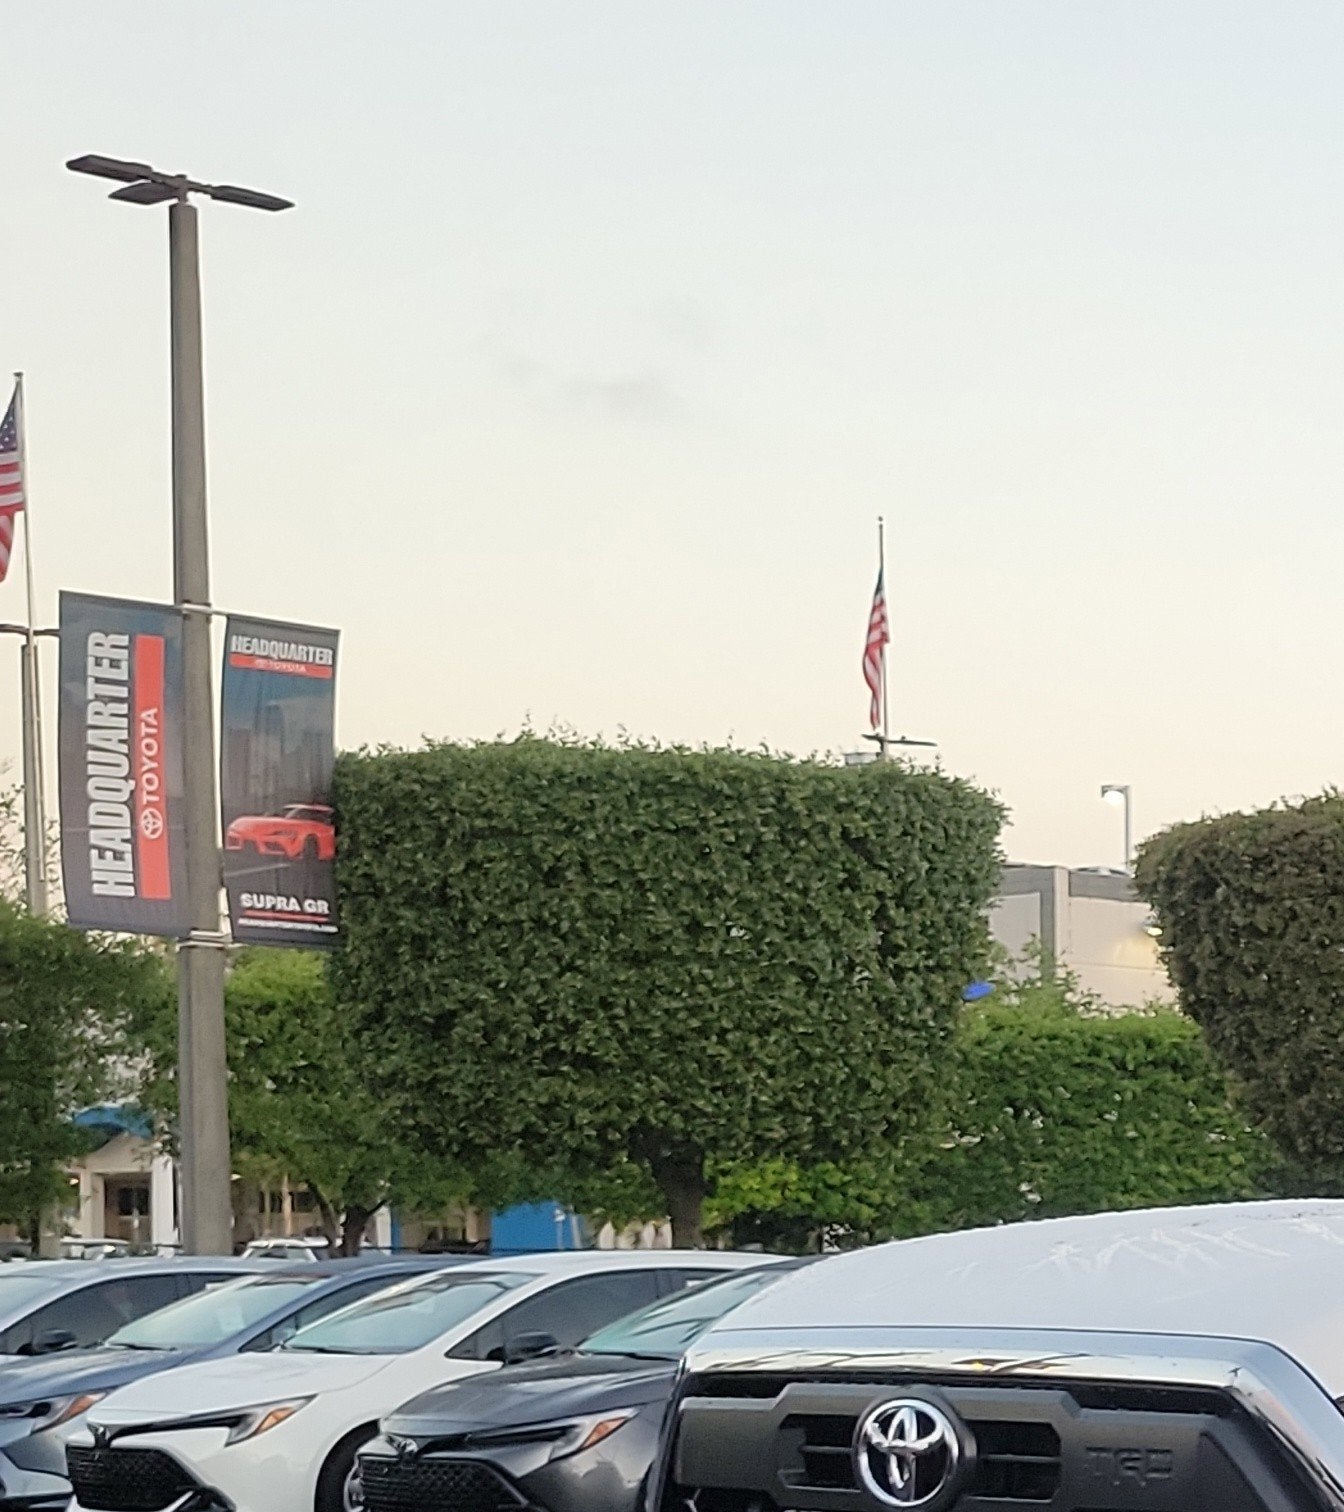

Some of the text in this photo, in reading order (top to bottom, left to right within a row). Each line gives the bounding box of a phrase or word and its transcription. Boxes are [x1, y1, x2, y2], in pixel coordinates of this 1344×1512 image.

[231, 635, 333, 666] HEADQUARTER
[87, 632, 135, 897] HEADQUARTER
[140, 707, 160, 805] TOYOTA
[240, 893, 330, 914] SUPRA GR
